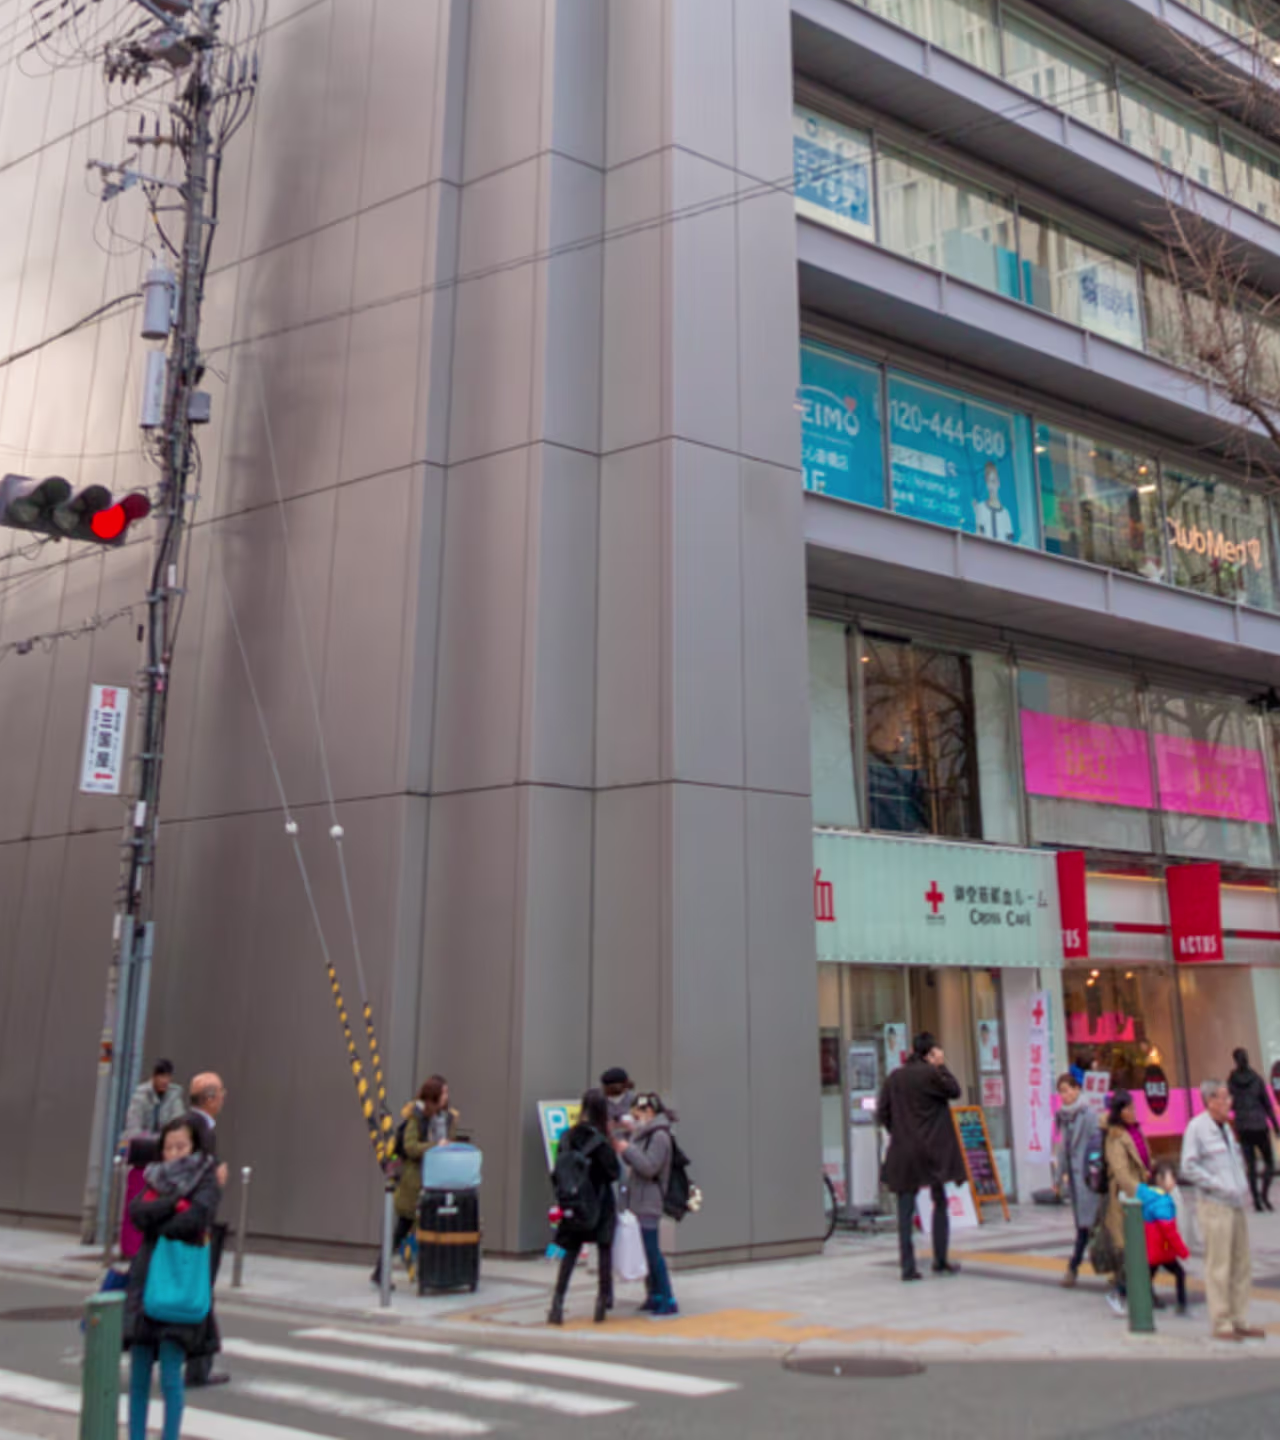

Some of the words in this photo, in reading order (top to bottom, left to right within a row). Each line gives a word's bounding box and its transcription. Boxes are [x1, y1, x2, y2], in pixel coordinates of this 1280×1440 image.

[1062, 929, 1081, 949] TUS
[1179, 935, 1217, 954] ACTUS
[1145, 1081, 1166, 1097] SALE
